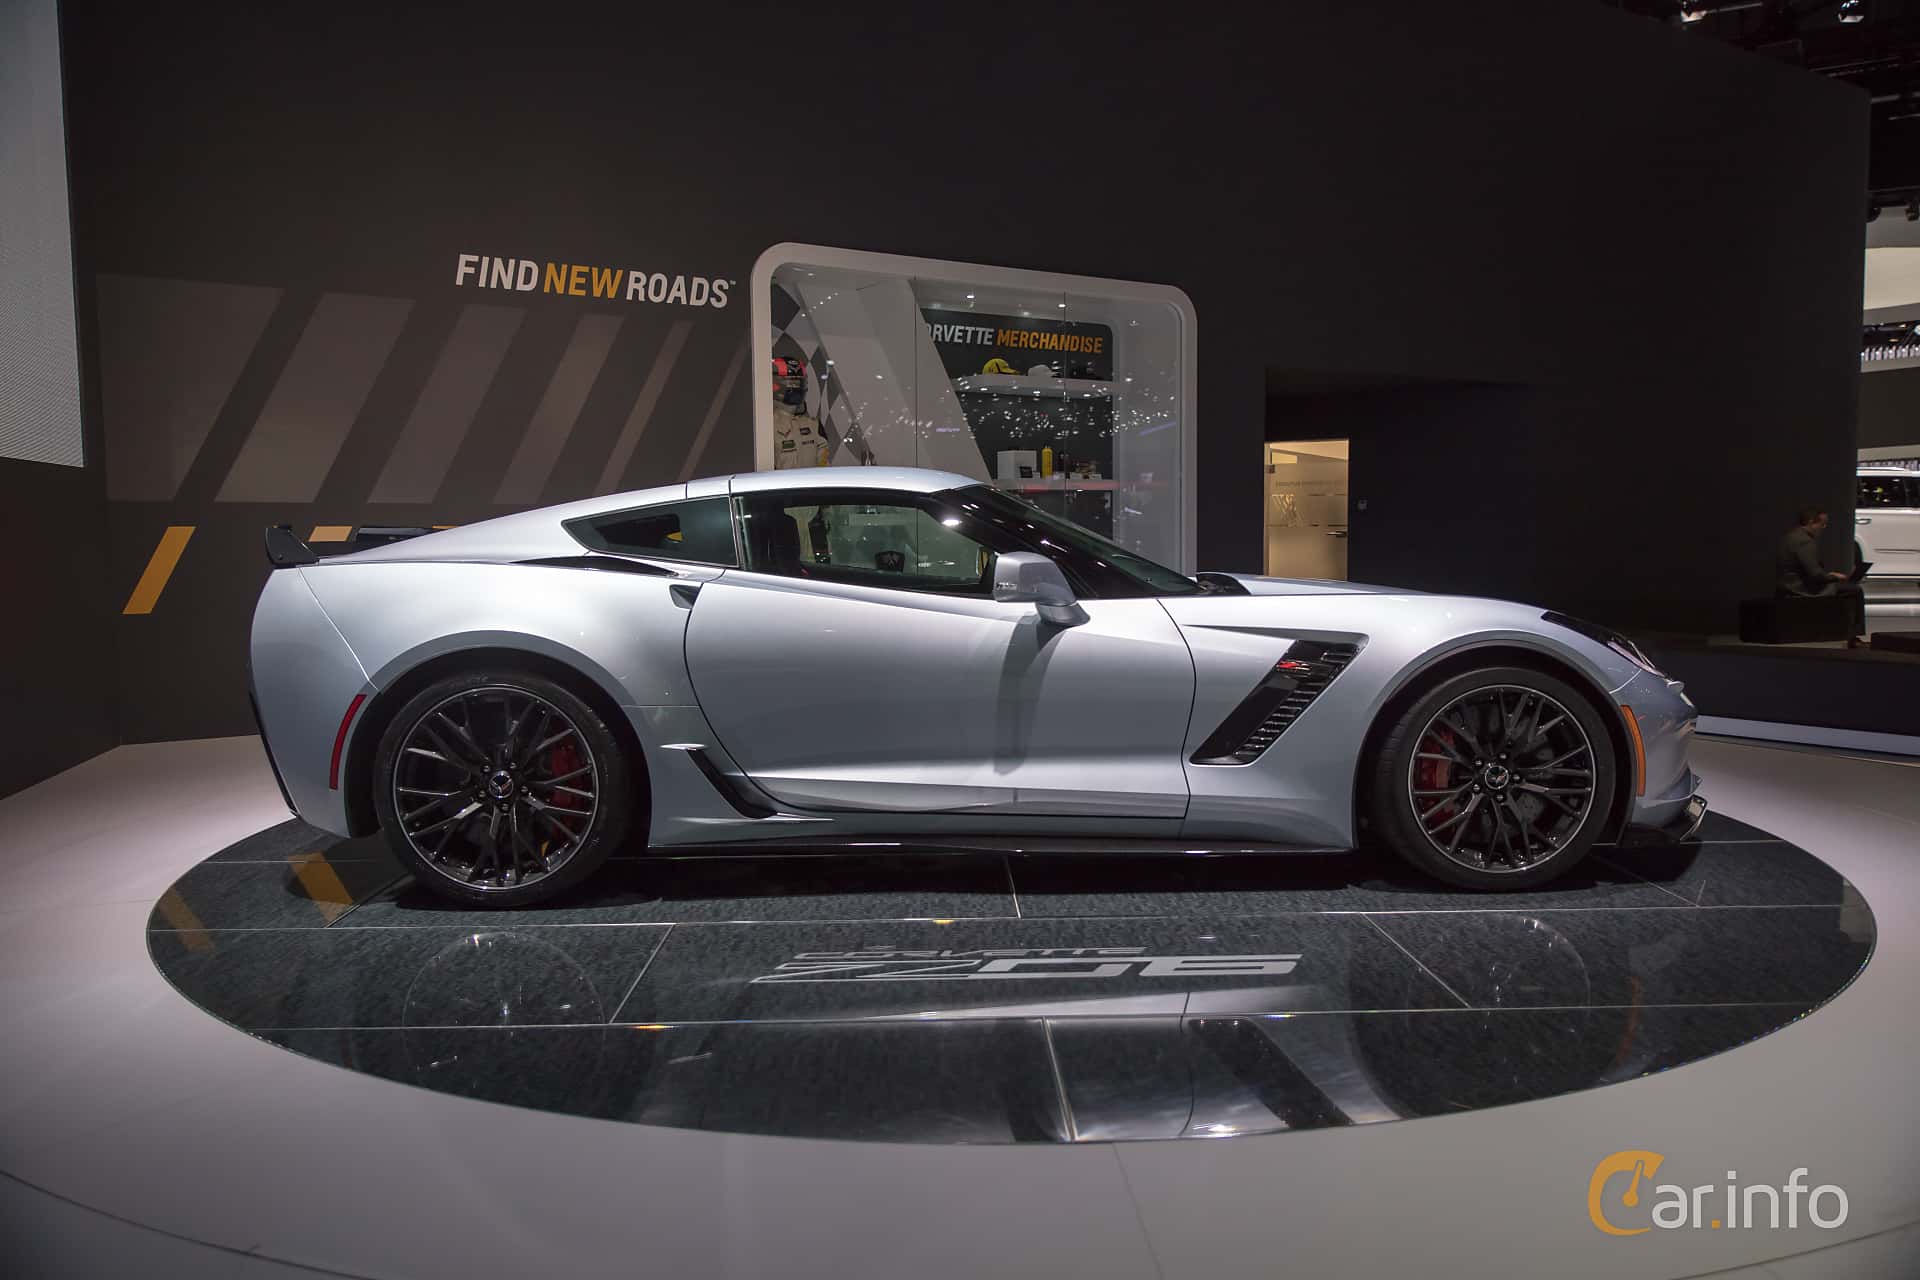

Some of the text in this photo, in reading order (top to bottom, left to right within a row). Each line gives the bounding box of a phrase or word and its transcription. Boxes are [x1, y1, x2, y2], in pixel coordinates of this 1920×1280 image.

[455, 254, 730, 309] FIND NEW ROADS
[996, 329, 1103, 353] MERCHANDISE
[749, 953, 1304, 984] Z06
